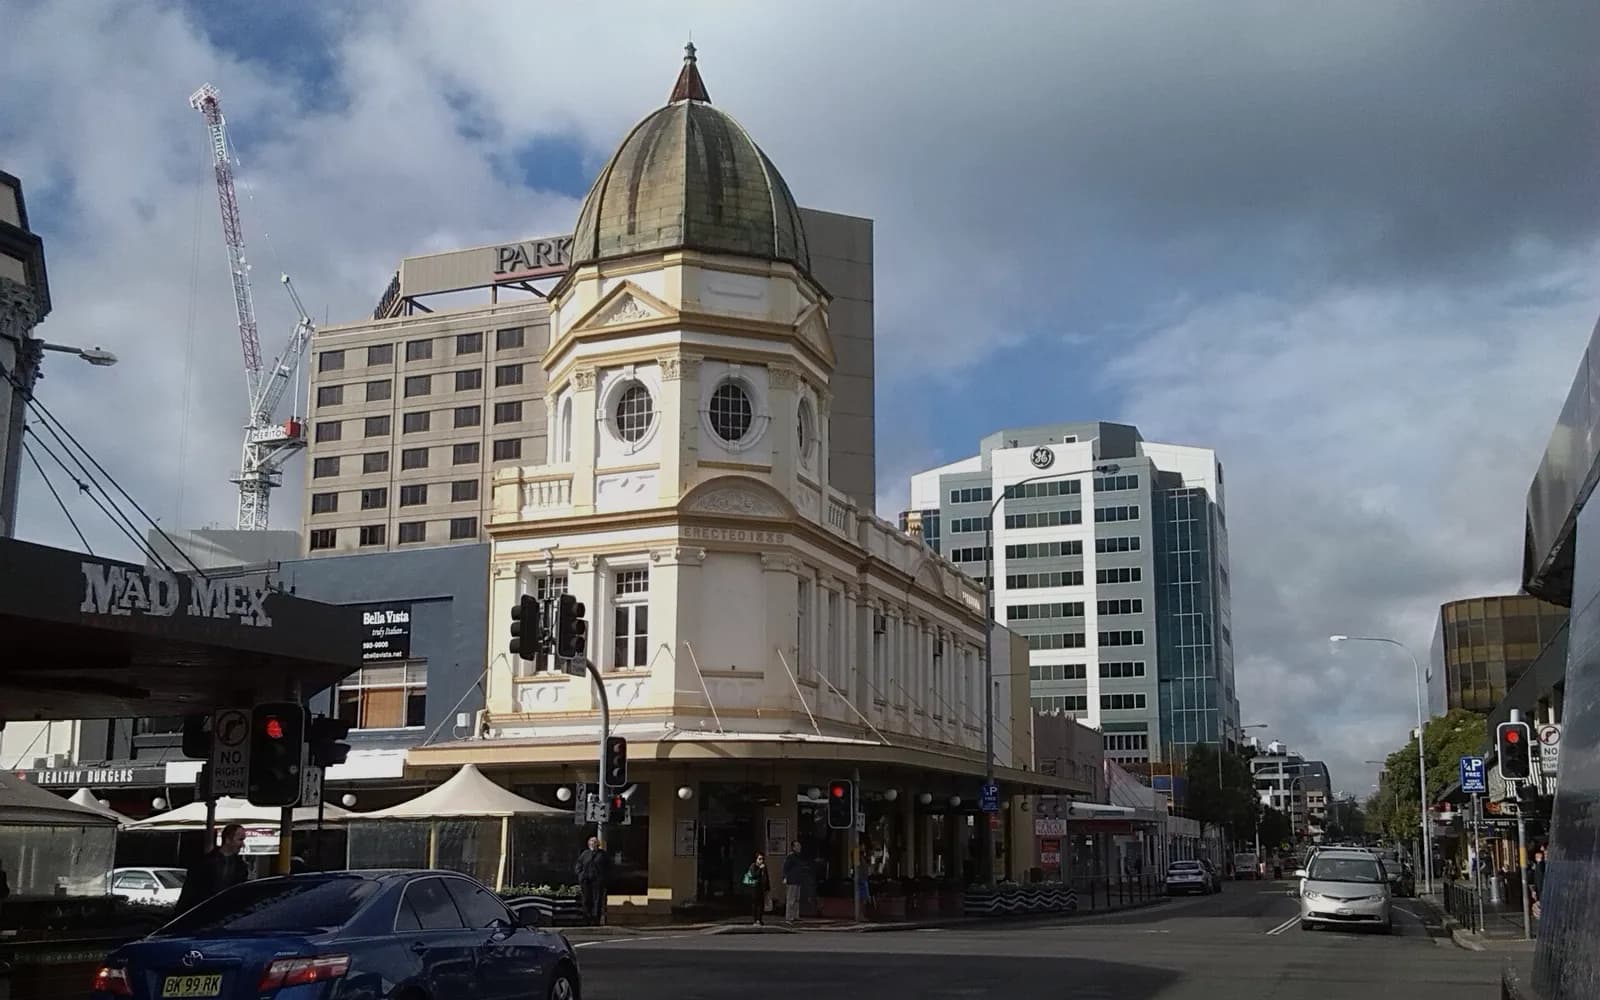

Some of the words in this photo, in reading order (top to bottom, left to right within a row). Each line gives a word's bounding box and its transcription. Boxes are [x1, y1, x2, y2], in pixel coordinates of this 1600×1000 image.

[494, 238, 573, 274] PARK
[684, 527, 746, 541] ERECTED
[80, 561, 179, 617] MAD
[187, 573, 273, 627] MEX
[363, 611, 385, 625] Bella
[385, 610, 409, 623] Vista
[220, 751, 241, 763] NO
[1544, 747, 1558, 755] NO
[38, 770, 81, 783] HEALTHY
[87, 769, 133, 783] BURGERS
[215, 766, 246, 776] RIGHT
[216, 778, 245, 788] TURN
